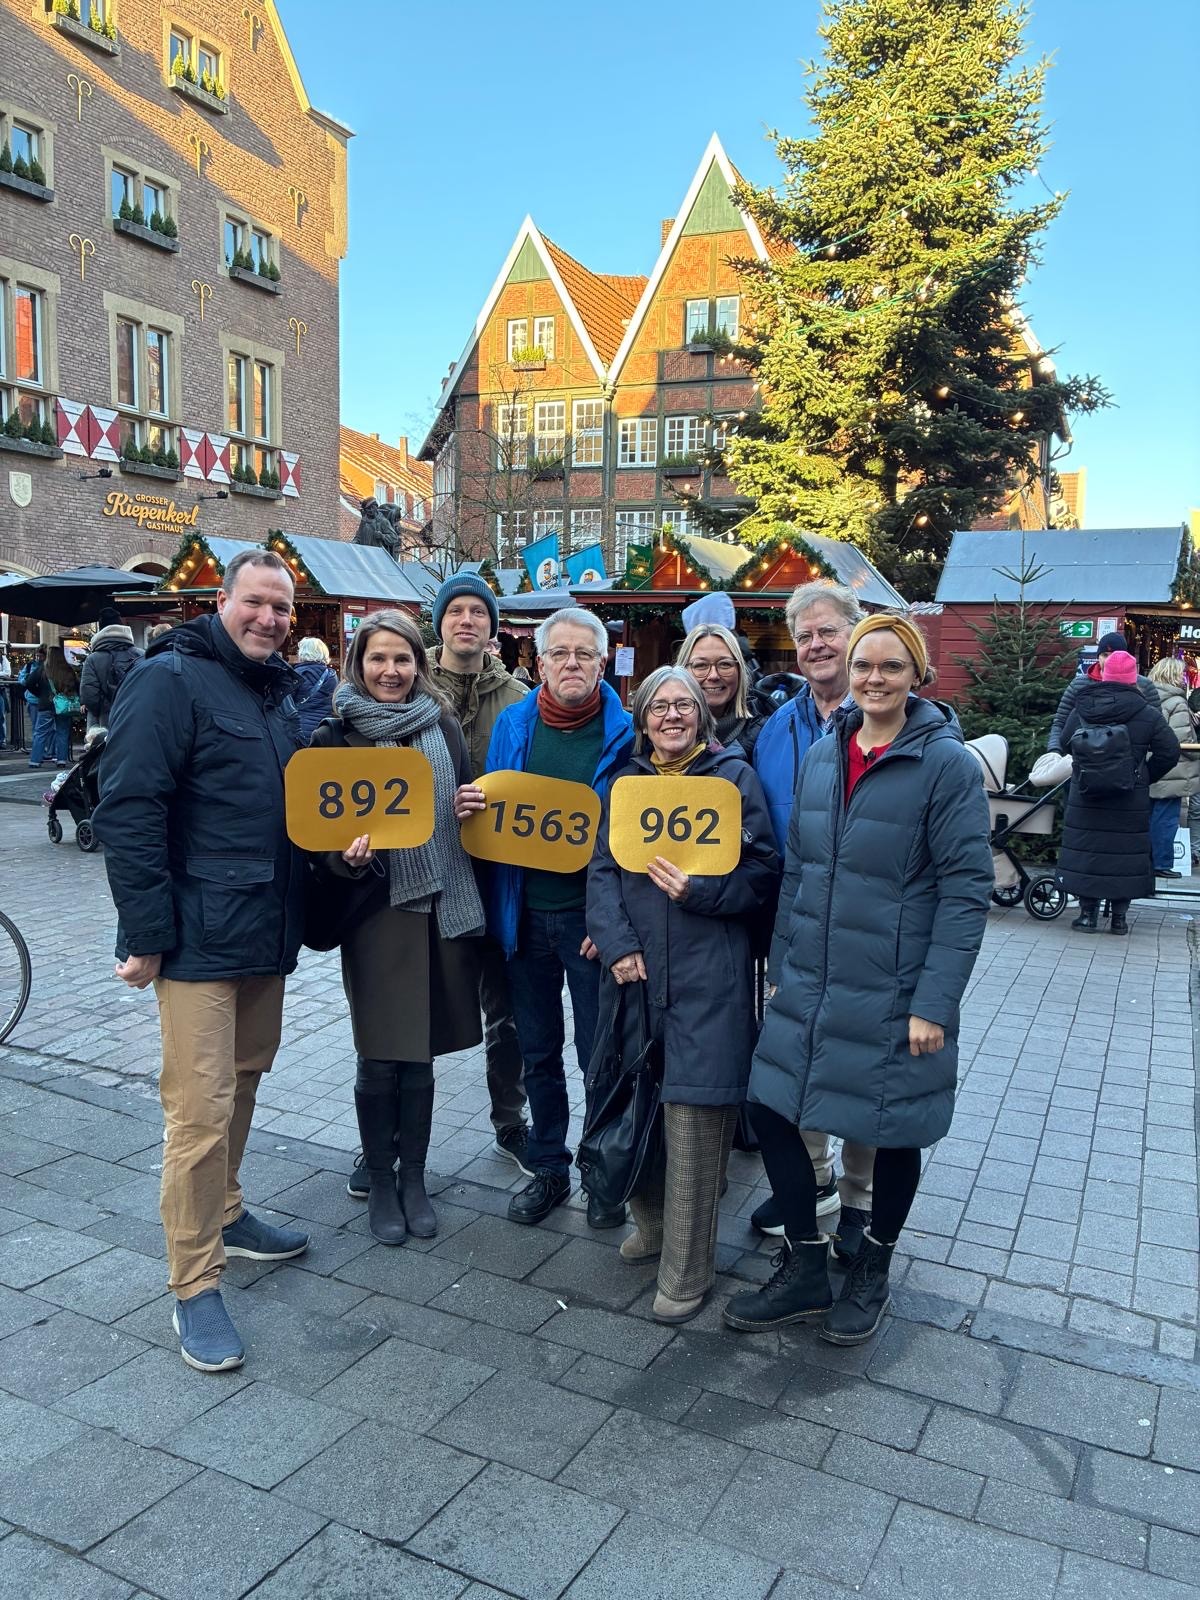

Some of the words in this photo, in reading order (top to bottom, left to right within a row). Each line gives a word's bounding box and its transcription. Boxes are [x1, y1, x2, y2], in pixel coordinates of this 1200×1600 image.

[103, 492, 199, 527] Kiepenkerl
[135, 493, 168, 506] GROSSER
[146, 521, 184, 534] GASTHAUS
[318, 777, 411, 820] 892
[489, 800, 591, 846] 1563
[640, 805, 721, 845] 962
